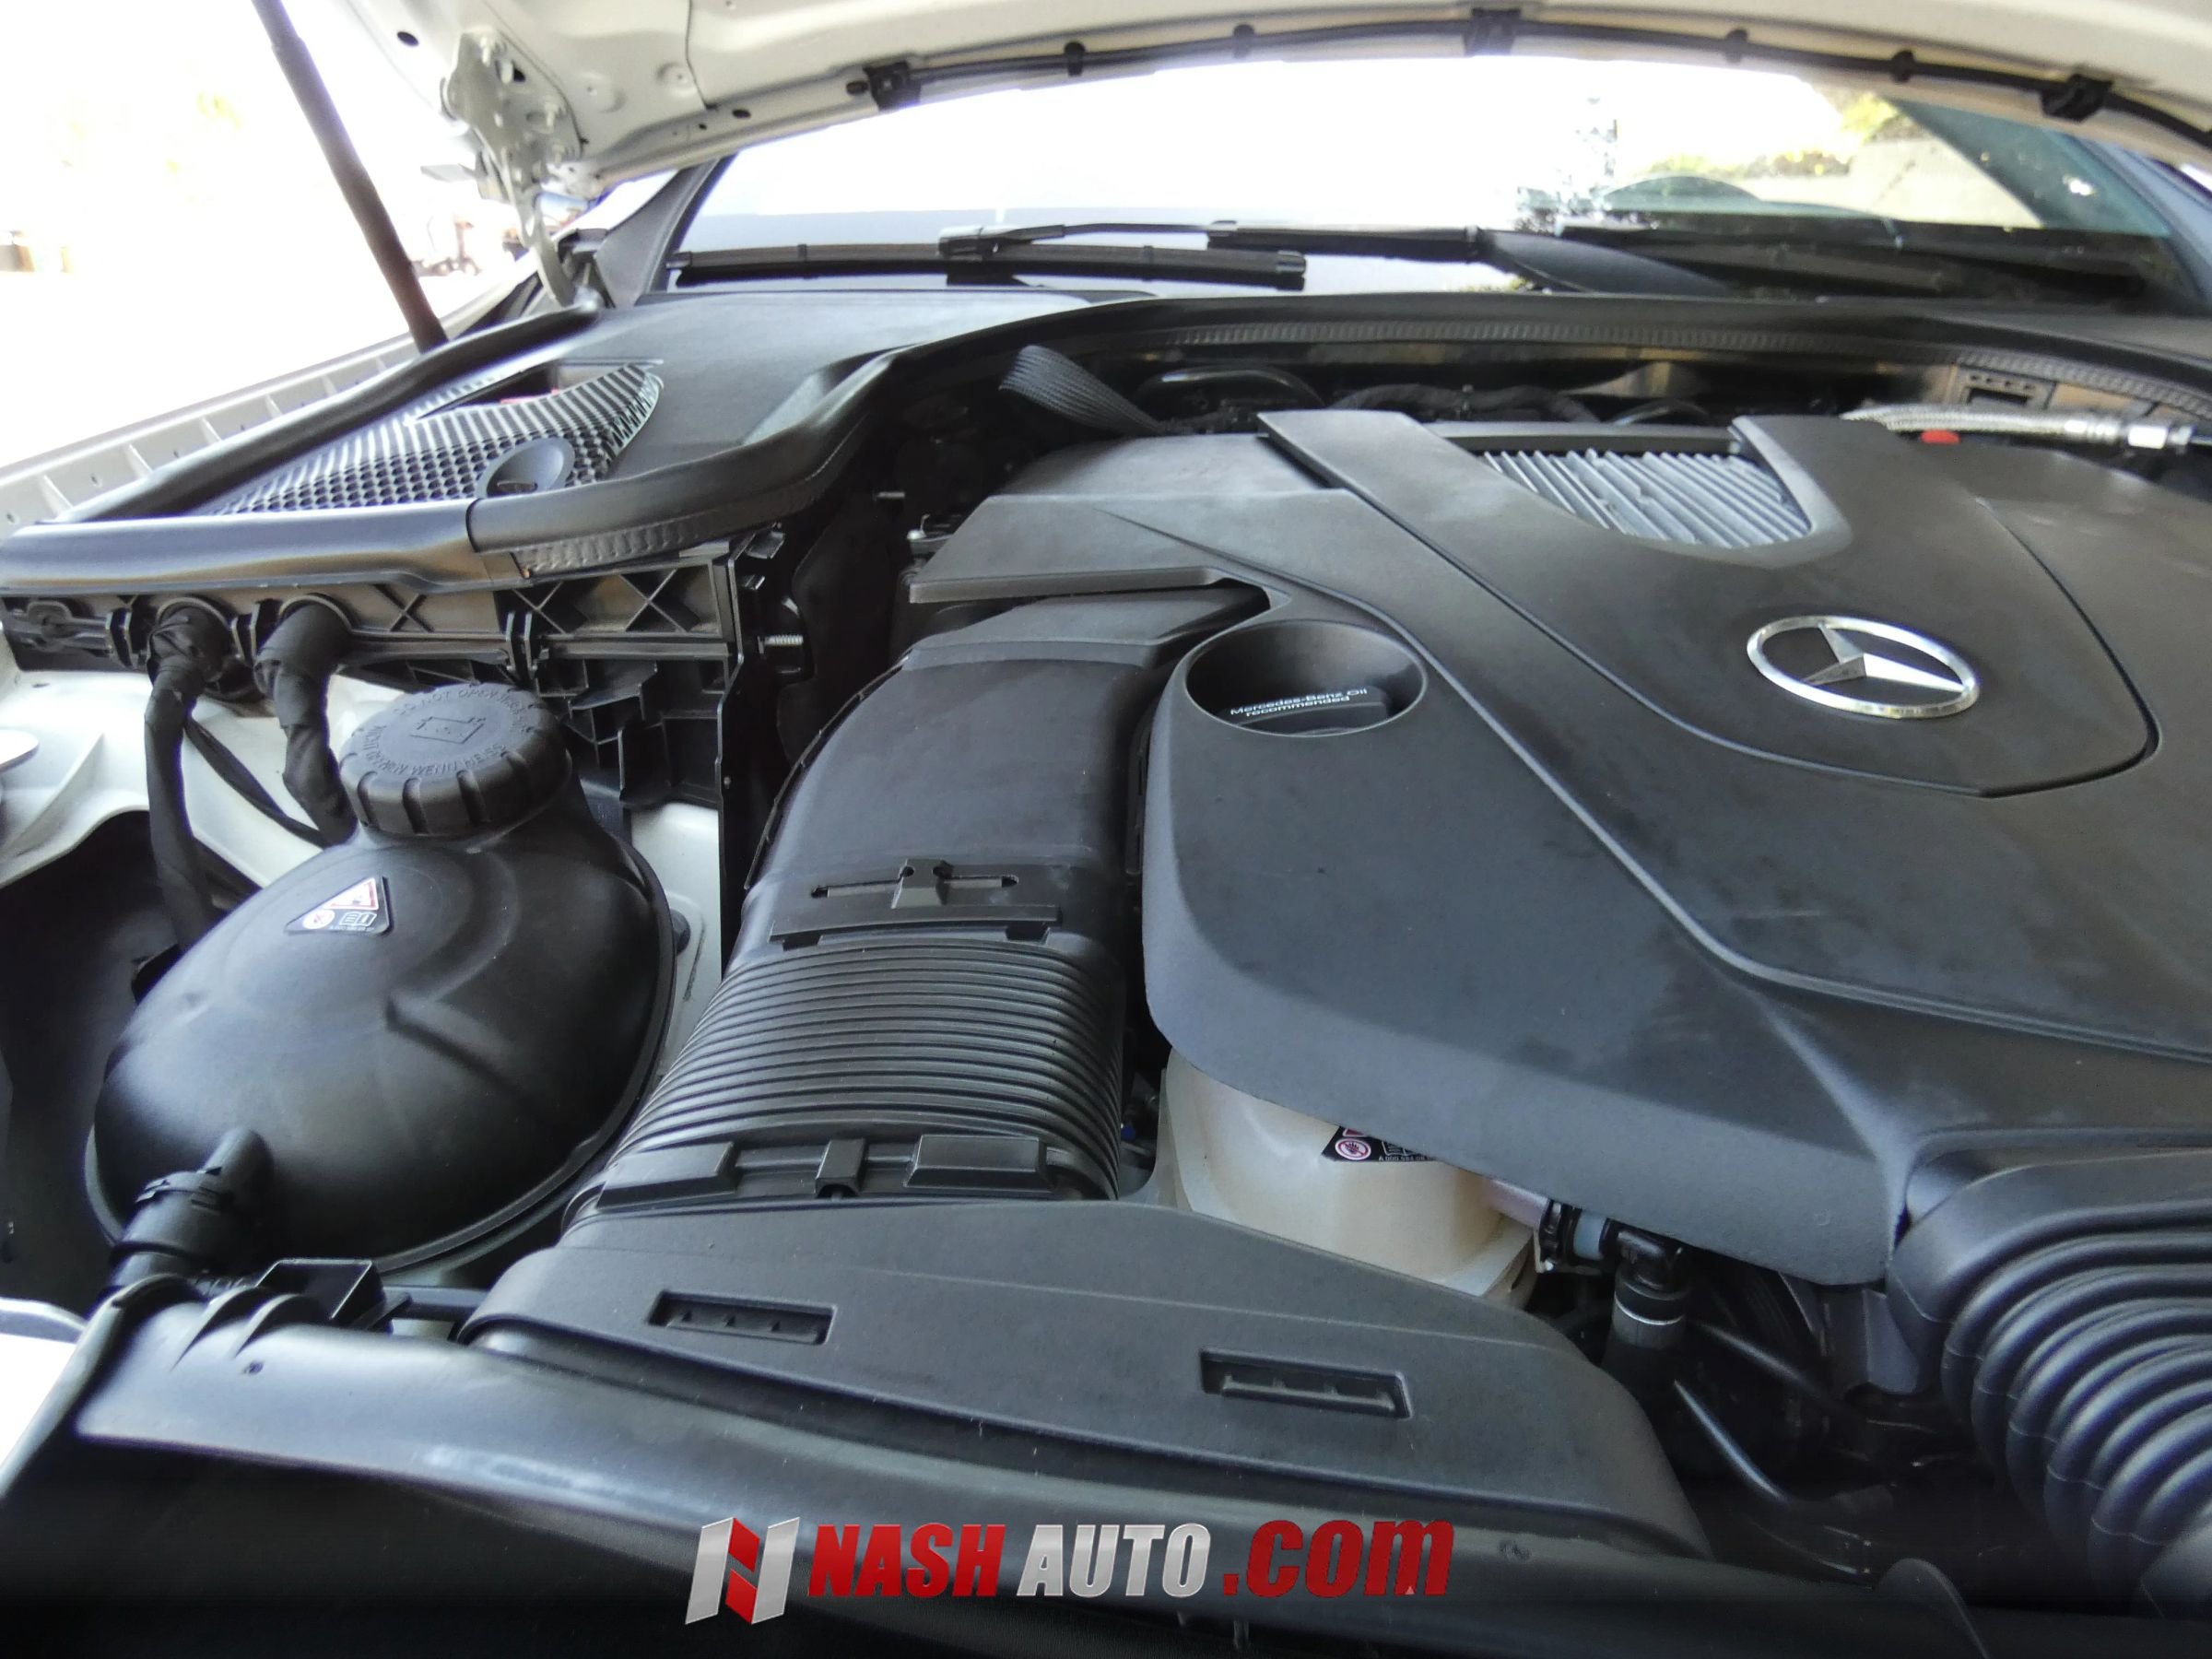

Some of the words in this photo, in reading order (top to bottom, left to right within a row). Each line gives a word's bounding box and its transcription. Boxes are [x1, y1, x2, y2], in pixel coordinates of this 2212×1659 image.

[421, 691, 450, 706] NOT
[458, 688, 498, 701] OPEN
[1230, 691, 1344, 715] Mercedes-Benz
[1347, 688, 1368, 697] Oil
[1246, 695, 1350, 717] recommended
